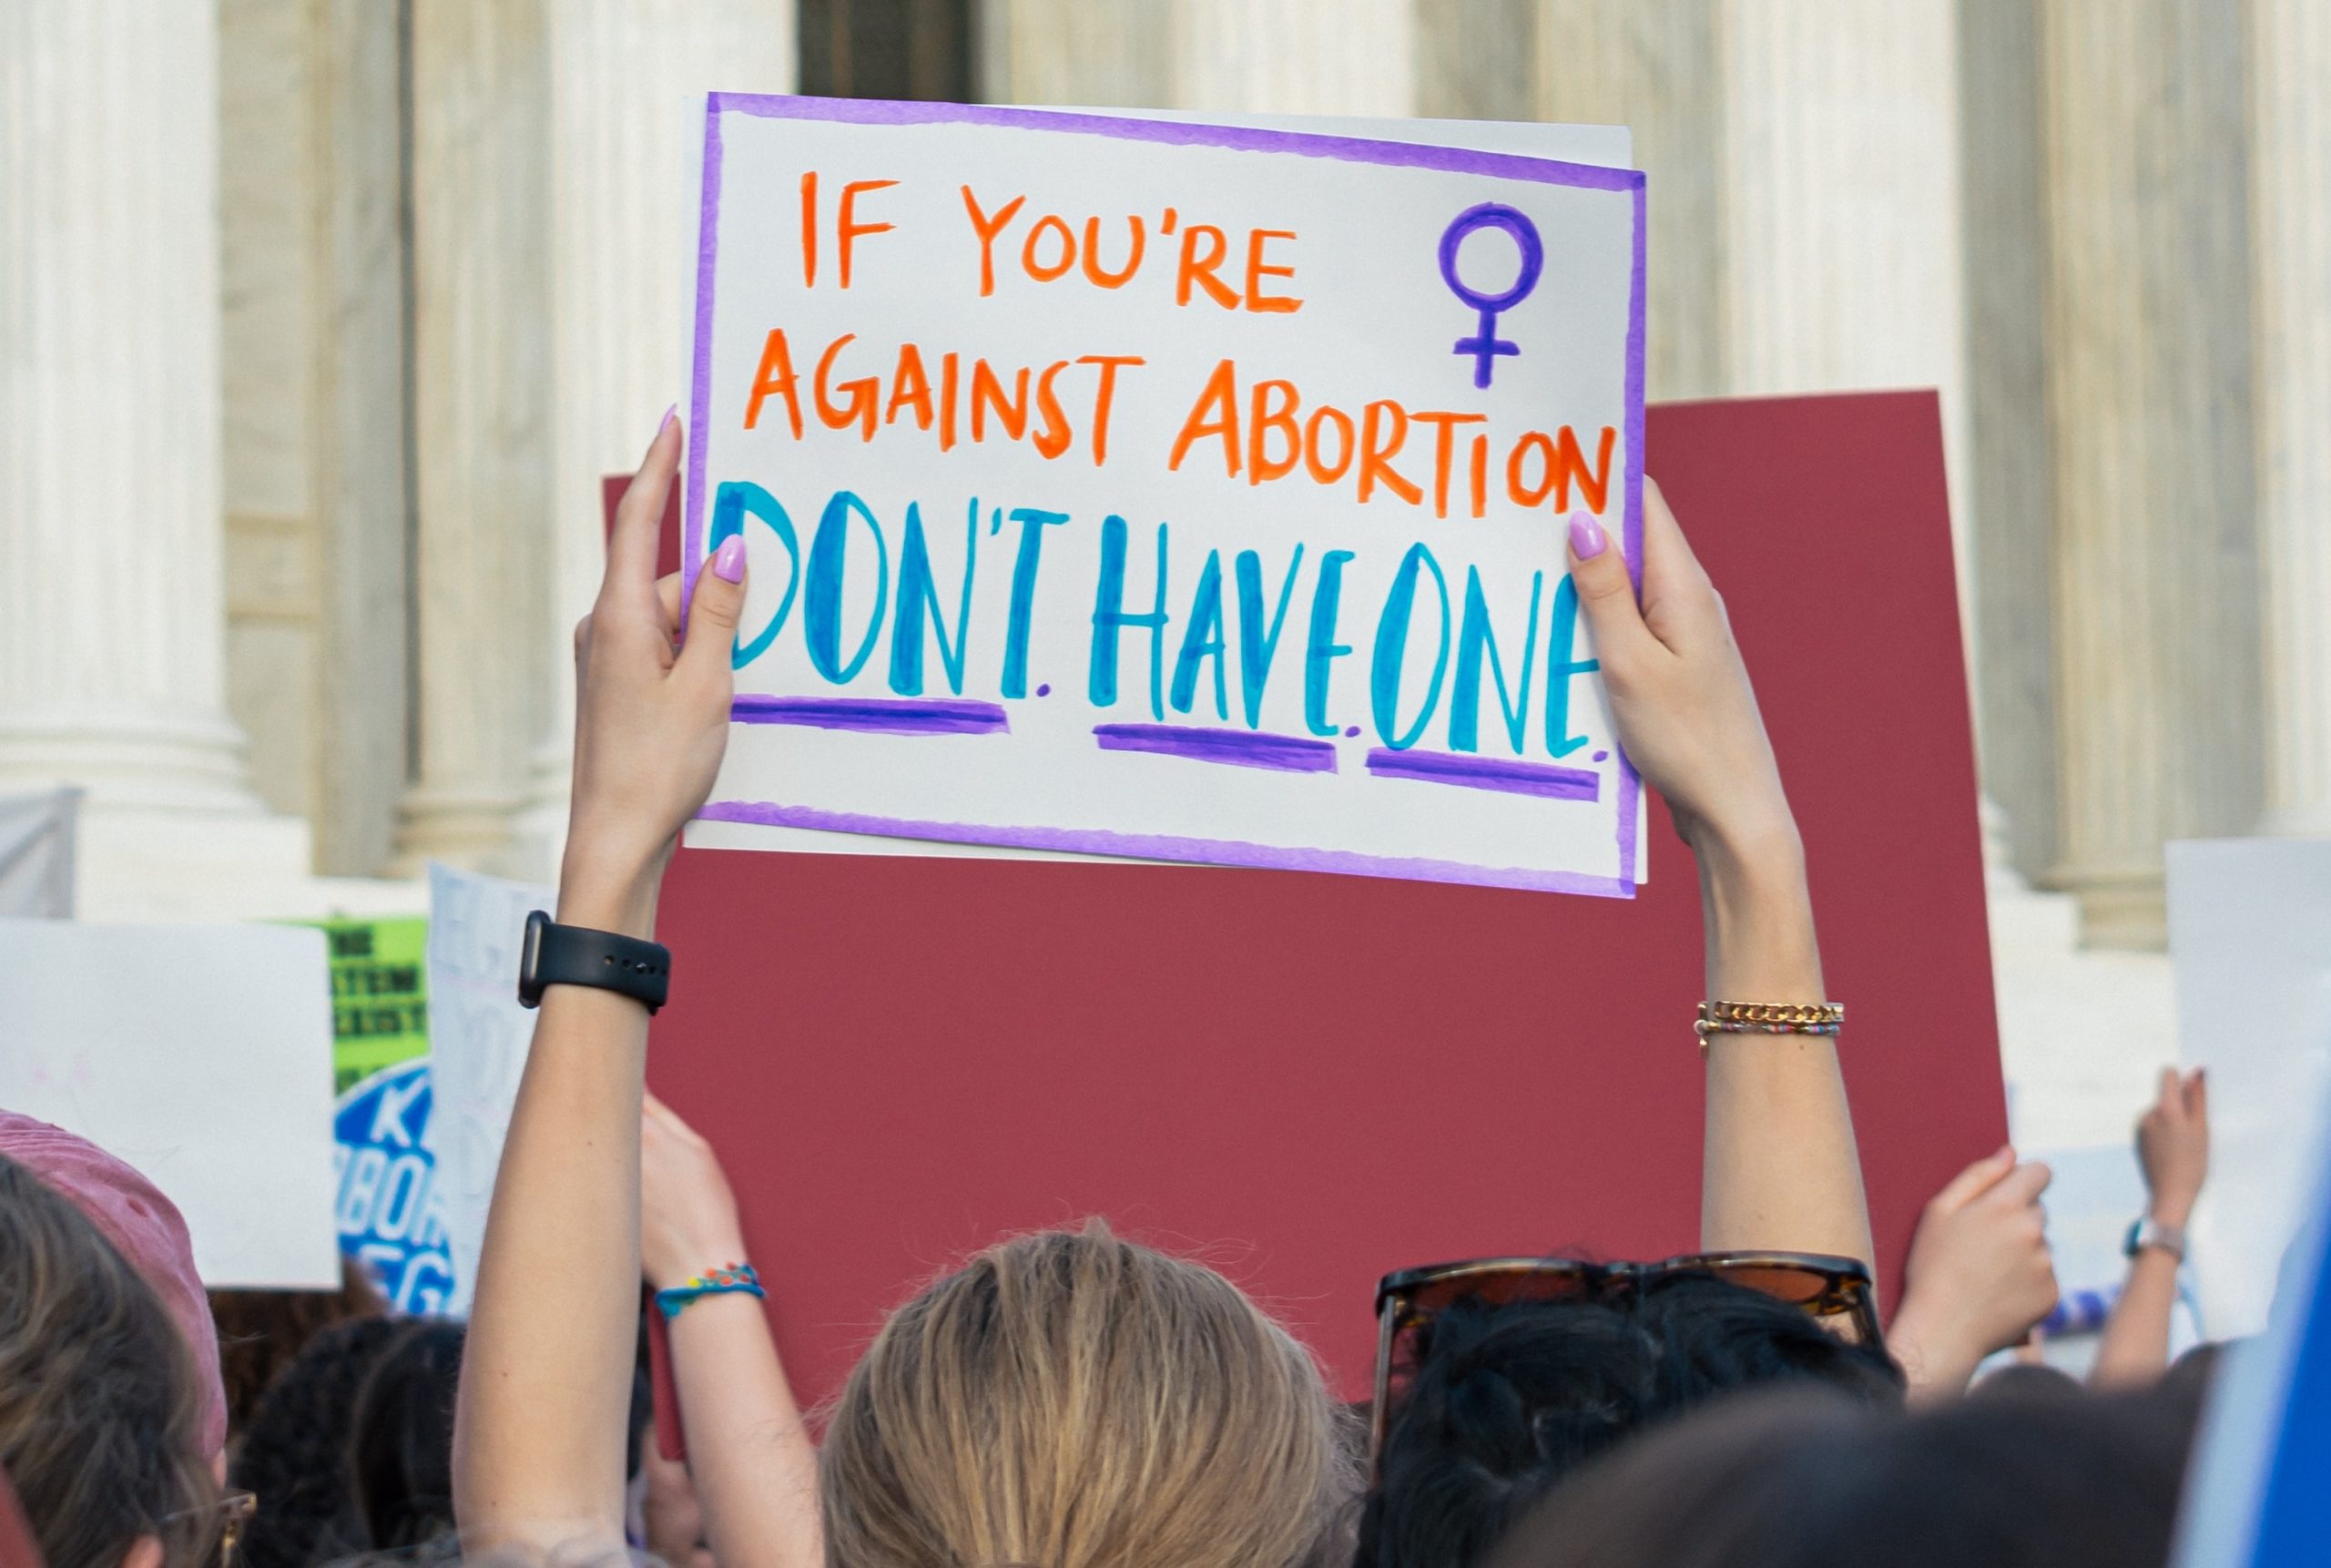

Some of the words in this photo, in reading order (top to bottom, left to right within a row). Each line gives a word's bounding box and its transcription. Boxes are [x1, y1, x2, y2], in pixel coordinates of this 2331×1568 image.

[799, 170, 901, 290] IF
[960, 184, 1305, 314] YOU'RE
[742, 327, 1147, 468] AGAINST
[1167, 358, 1619, 519] ABORTION
